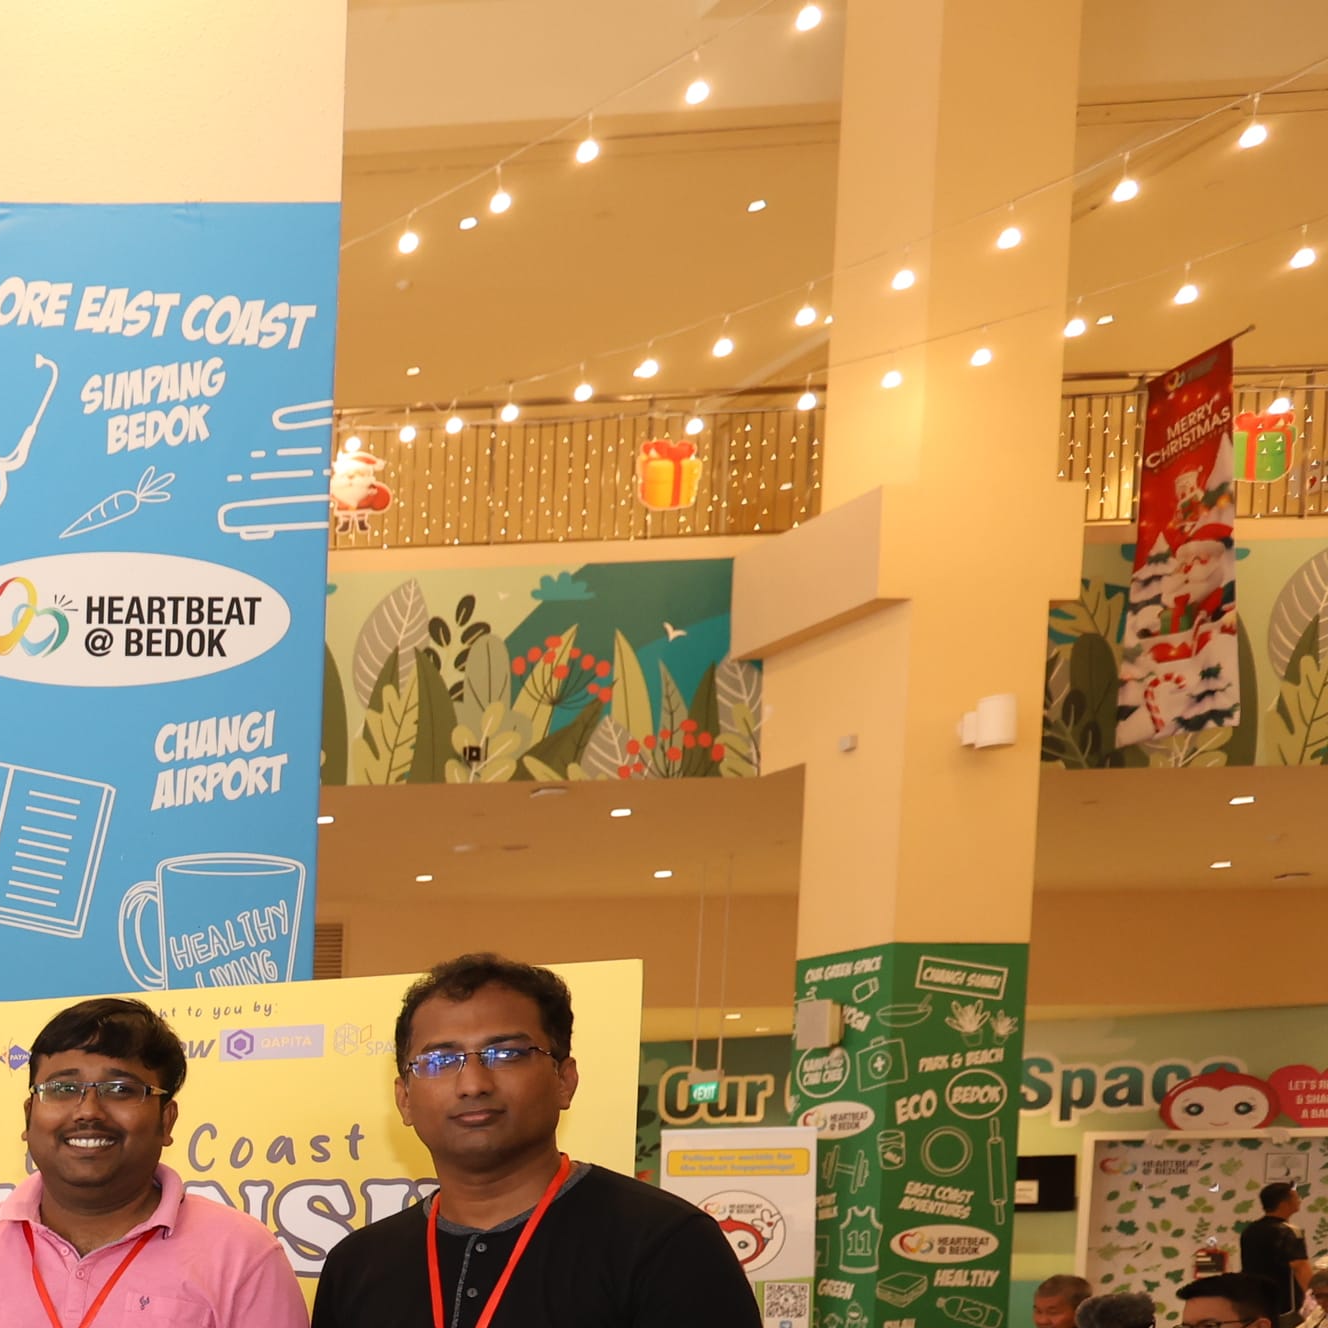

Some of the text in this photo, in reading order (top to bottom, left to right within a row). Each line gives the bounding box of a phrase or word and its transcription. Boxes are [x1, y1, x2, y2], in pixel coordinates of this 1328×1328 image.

[74, 284, 181, 339] EAST
[181, 294, 317, 350] COAST
[80, 356, 226, 415] SIMPANG
[106, 403, 211, 455] BEDOK
[1166, 399, 1214, 440] MERRY
[1145, 406, 1231, 469] CHRISTMAS
[85, 595, 263, 627] HEARTBEAT
[84, 627, 228, 658] @ BEDOK
[153, 709, 276, 764] CHANGI
[149, 753, 290, 812] AIRPORT
[169, 899, 289, 971] HEALTHY
[804, 954, 884, 984] OUR GREEN SPACE
[922, 966, 966, 989] CHANGI
[187, 1005, 203, 1018] to
[213, 1005, 243, 1020] you
[9, 1053, 31, 1061] PAYM
[260, 1035, 397, 1057] QAPITA SPA
[918, 1047, 1005, 1073] PARK & BEACH
[895, 1089, 938, 1125] ECO
[950, 1085, 1002, 1105] BEDOK
[830, 1111, 869, 1123] HEARTBEAT
[837, 1121, 862, 1132] BEDOK
[187, 1122, 366, 1173] Coast
[1142, 1159, 1201, 1168] HEARTBEAT
[903, 1180, 975, 1203] EAST COAST
[898, 1198, 972, 1220] ADVENTURES
[846, 1230, 872, 1256] 11
[936, 1236, 990, 1247] HEARTBEAT
[948, 1245, 980, 1256] BEDOK
[817, 1279, 856, 1300] GREEN
[933, 1269, 1000, 1288] HEALTHY
